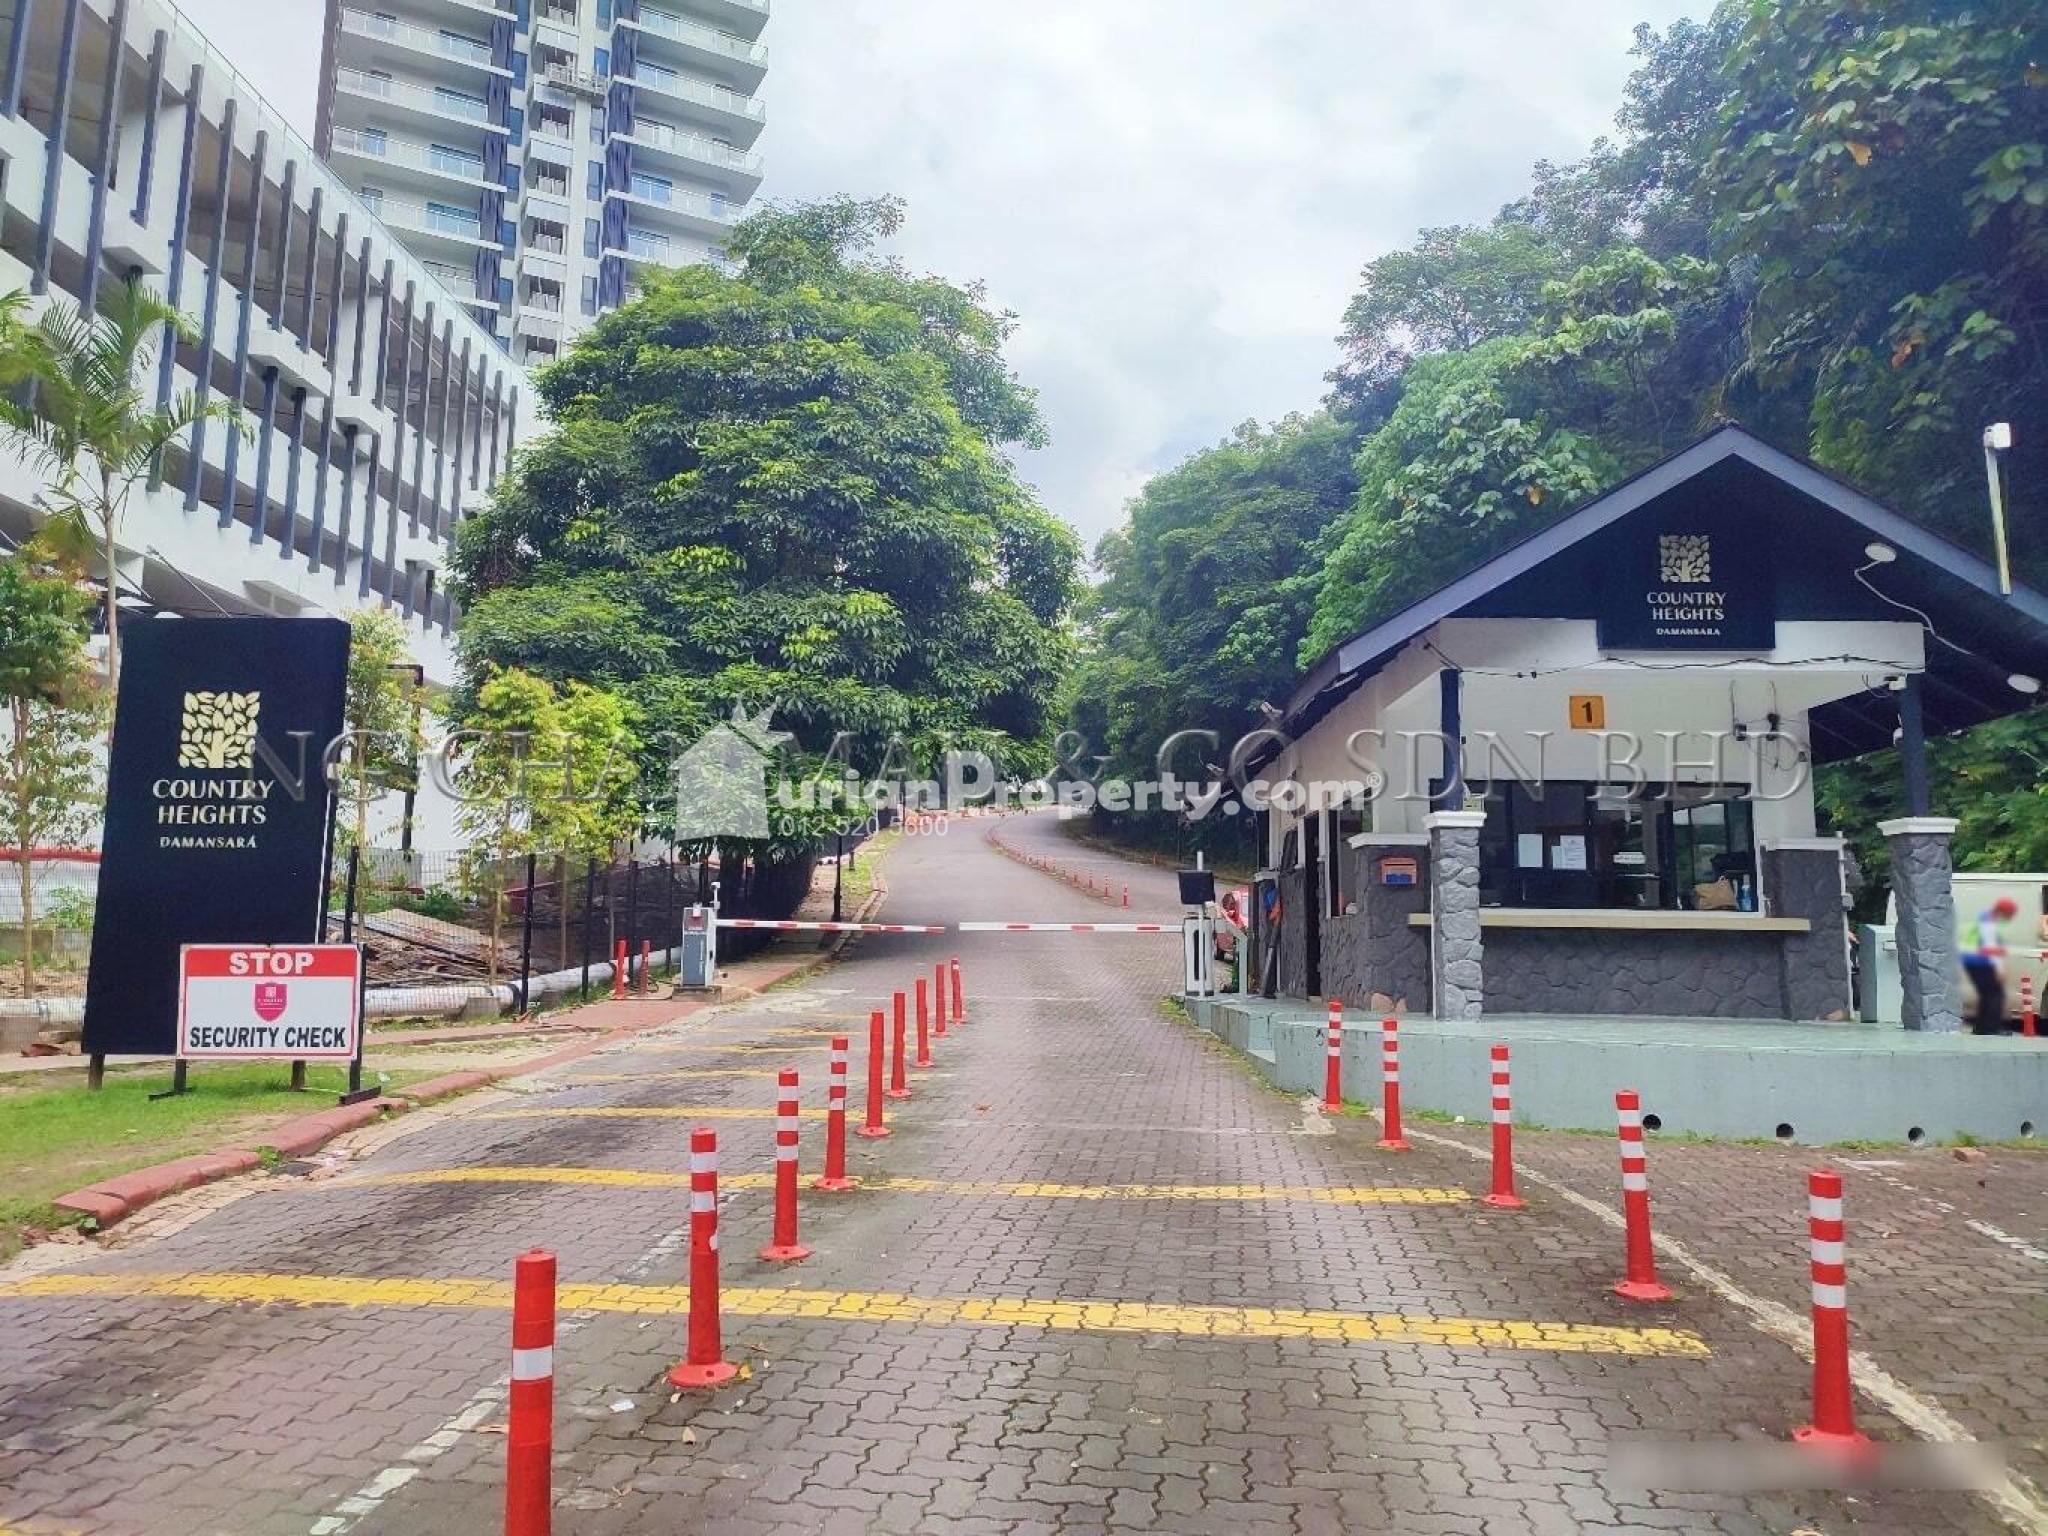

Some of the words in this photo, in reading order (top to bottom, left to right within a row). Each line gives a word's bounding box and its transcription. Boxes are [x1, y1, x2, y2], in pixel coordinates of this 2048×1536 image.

[1646, 592, 1727, 605] COUNTRY
[1652, 607, 1724, 621] HEIGHTS
[1655, 627, 1721, 636] DAMANSARA
[1582, 702, 1594, 723] 1
[152, 779, 275, 799] COUNTRY
[158, 804, 267, 825] HEIGHTS
[228, 951, 314, 975] STOP
[189, 1026, 279, 1048] SECURITY
[284, 1026, 346, 1048] CHECK
